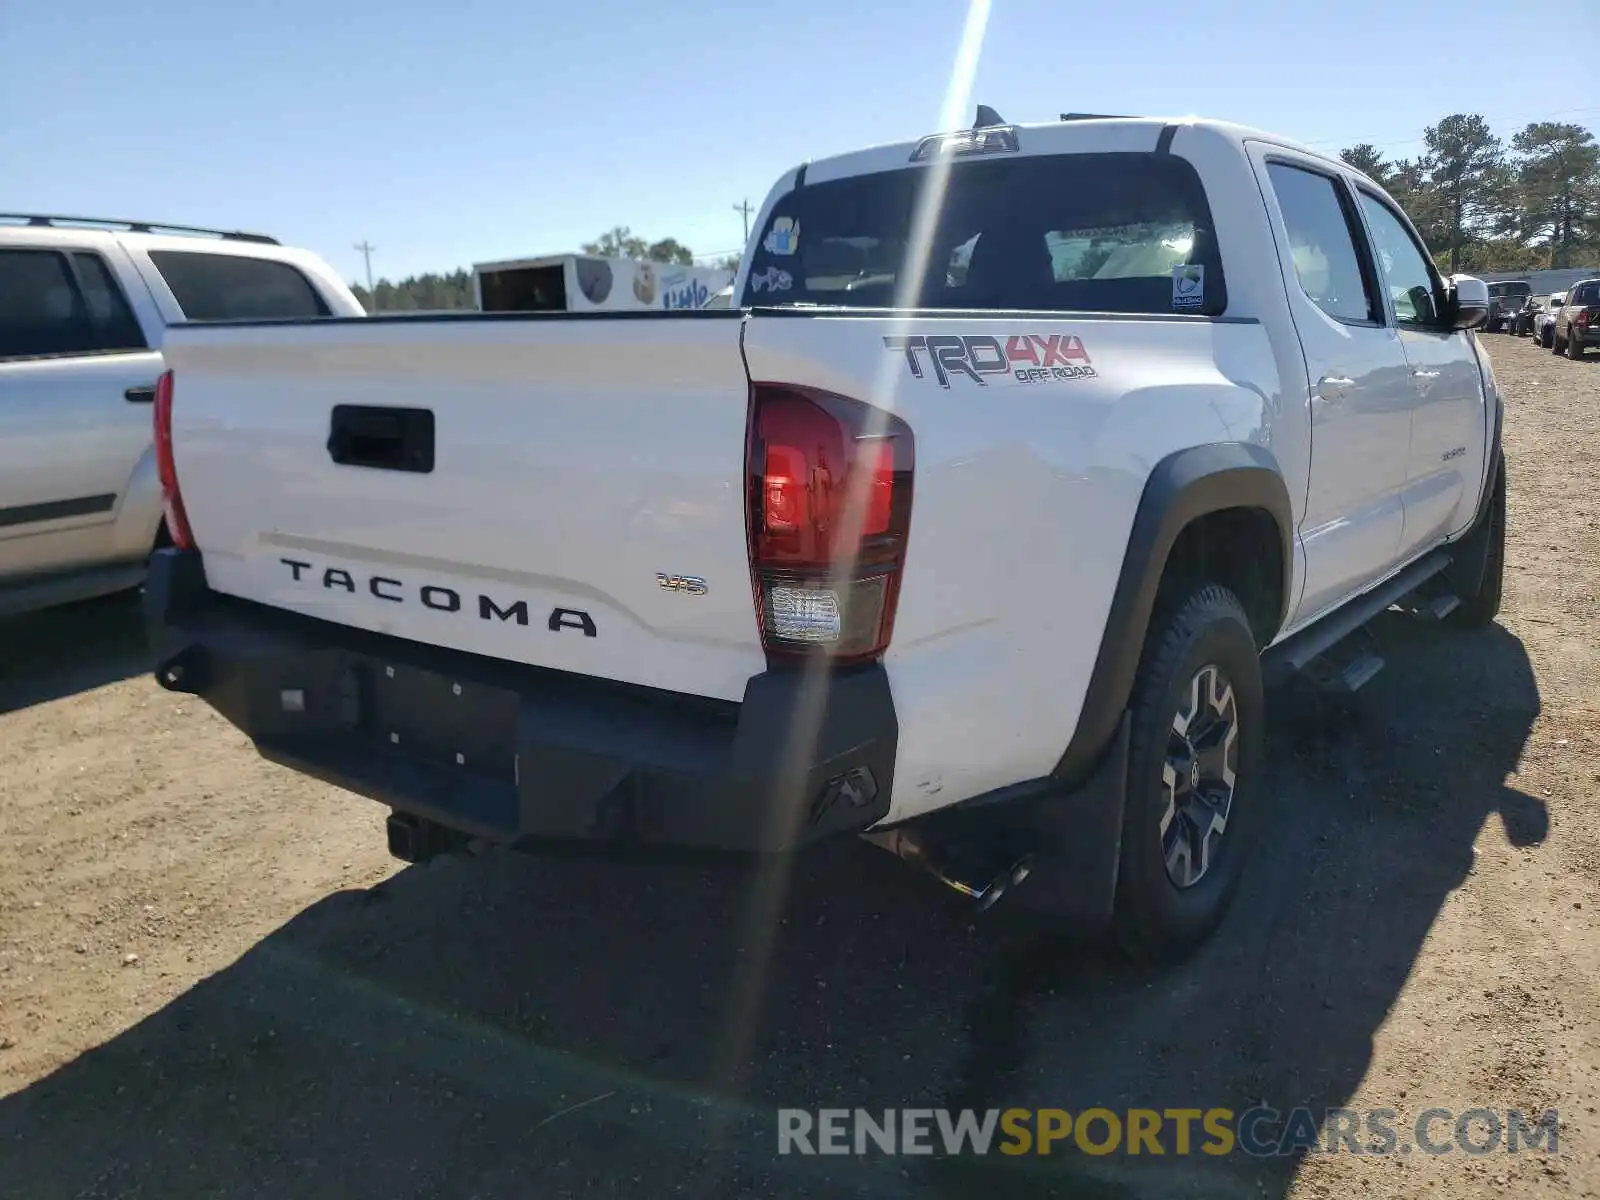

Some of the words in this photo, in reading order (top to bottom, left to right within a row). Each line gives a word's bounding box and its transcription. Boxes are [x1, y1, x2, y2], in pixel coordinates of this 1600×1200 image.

[1014, 367, 1050, 384] OFF
[1051, 364, 1098, 381] ROAD
[656, 572, 709, 597] V6
[280, 558, 598, 638] TACOMA
